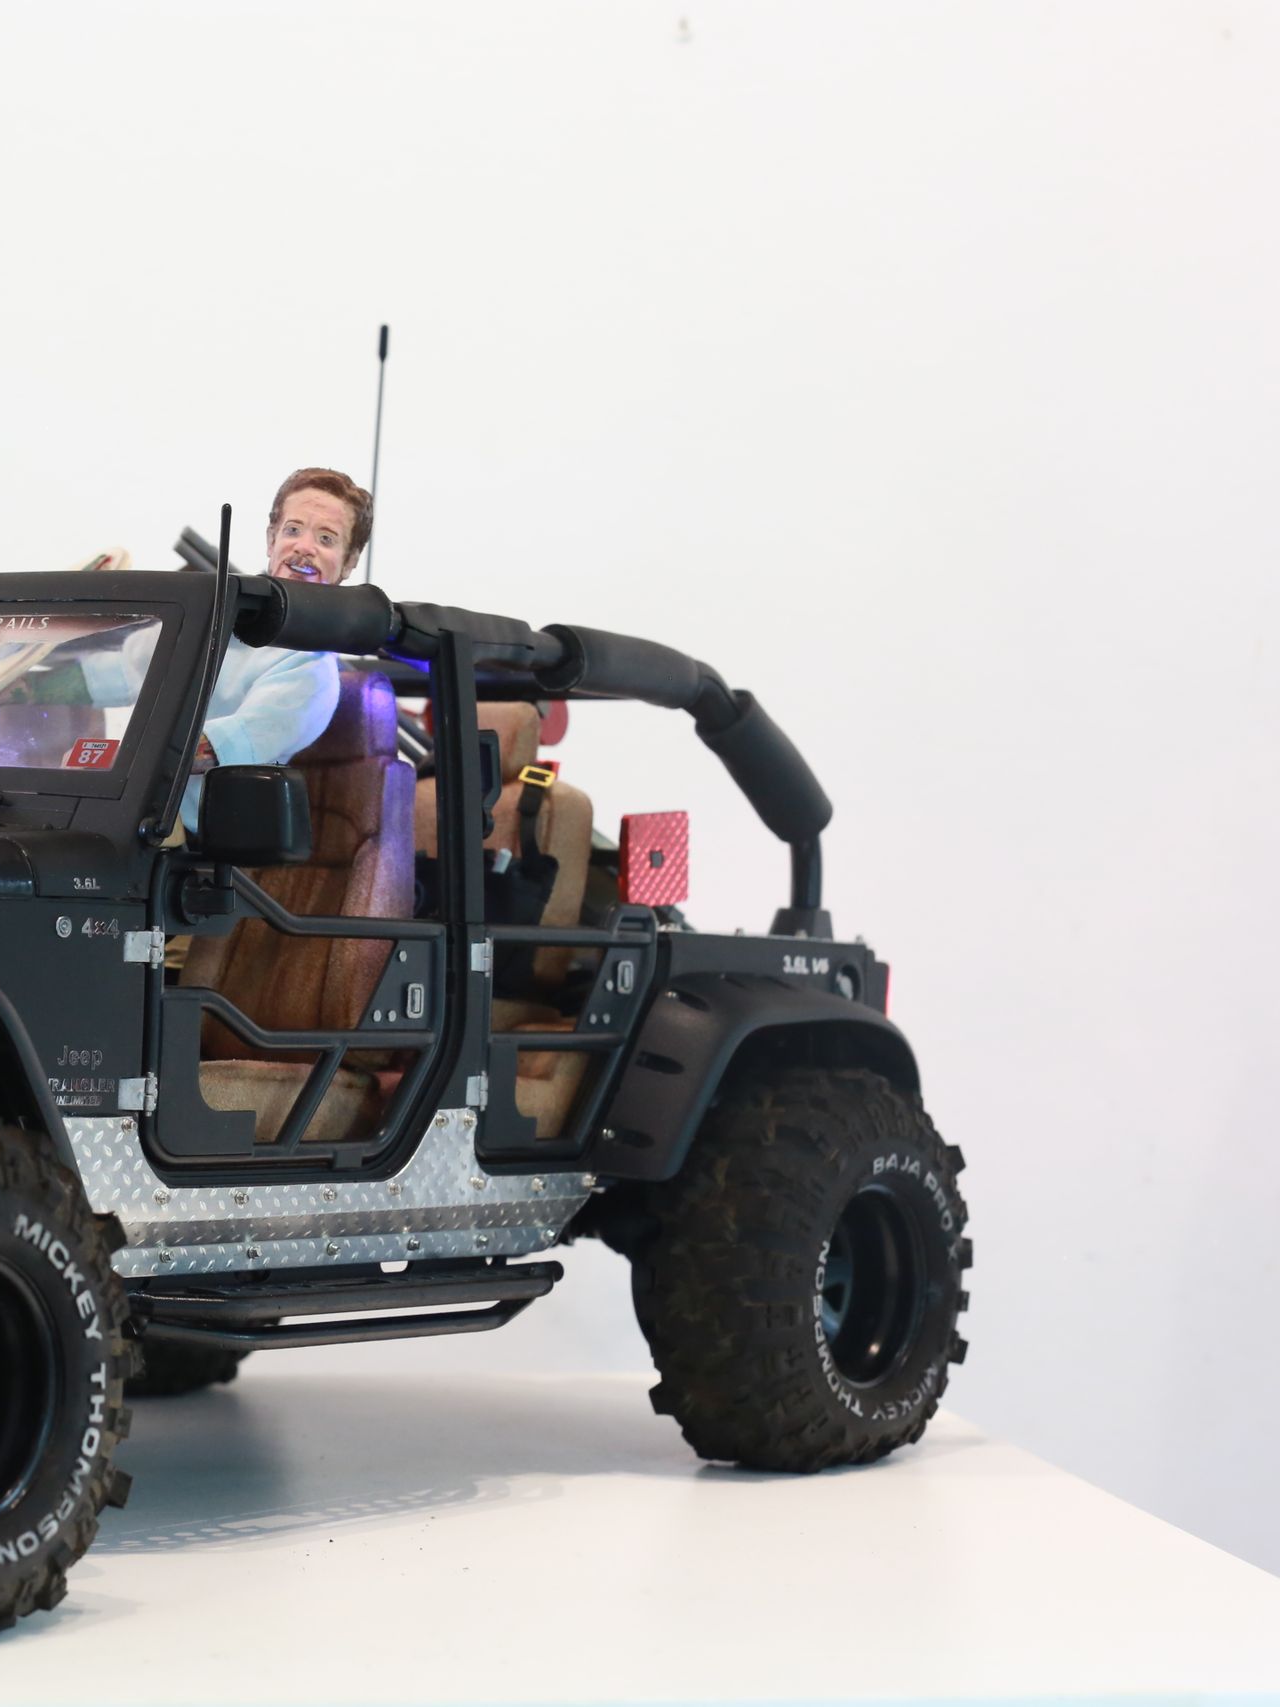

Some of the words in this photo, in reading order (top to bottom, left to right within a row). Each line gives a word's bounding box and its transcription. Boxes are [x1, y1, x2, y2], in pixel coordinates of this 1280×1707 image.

[78, 750, 105, 764] 87
[73, 877, 101, 890] 3.6L
[56, 1045, 104, 1071] Jeep
[873, 1151, 921, 1180] BAJA
[923, 1170, 954, 1232] PRO
[13, 1213, 104, 1341] MICKEY
[812, 1239, 865, 1418] THOMPSON
[871, 1361, 939, 1421] MICKEY
